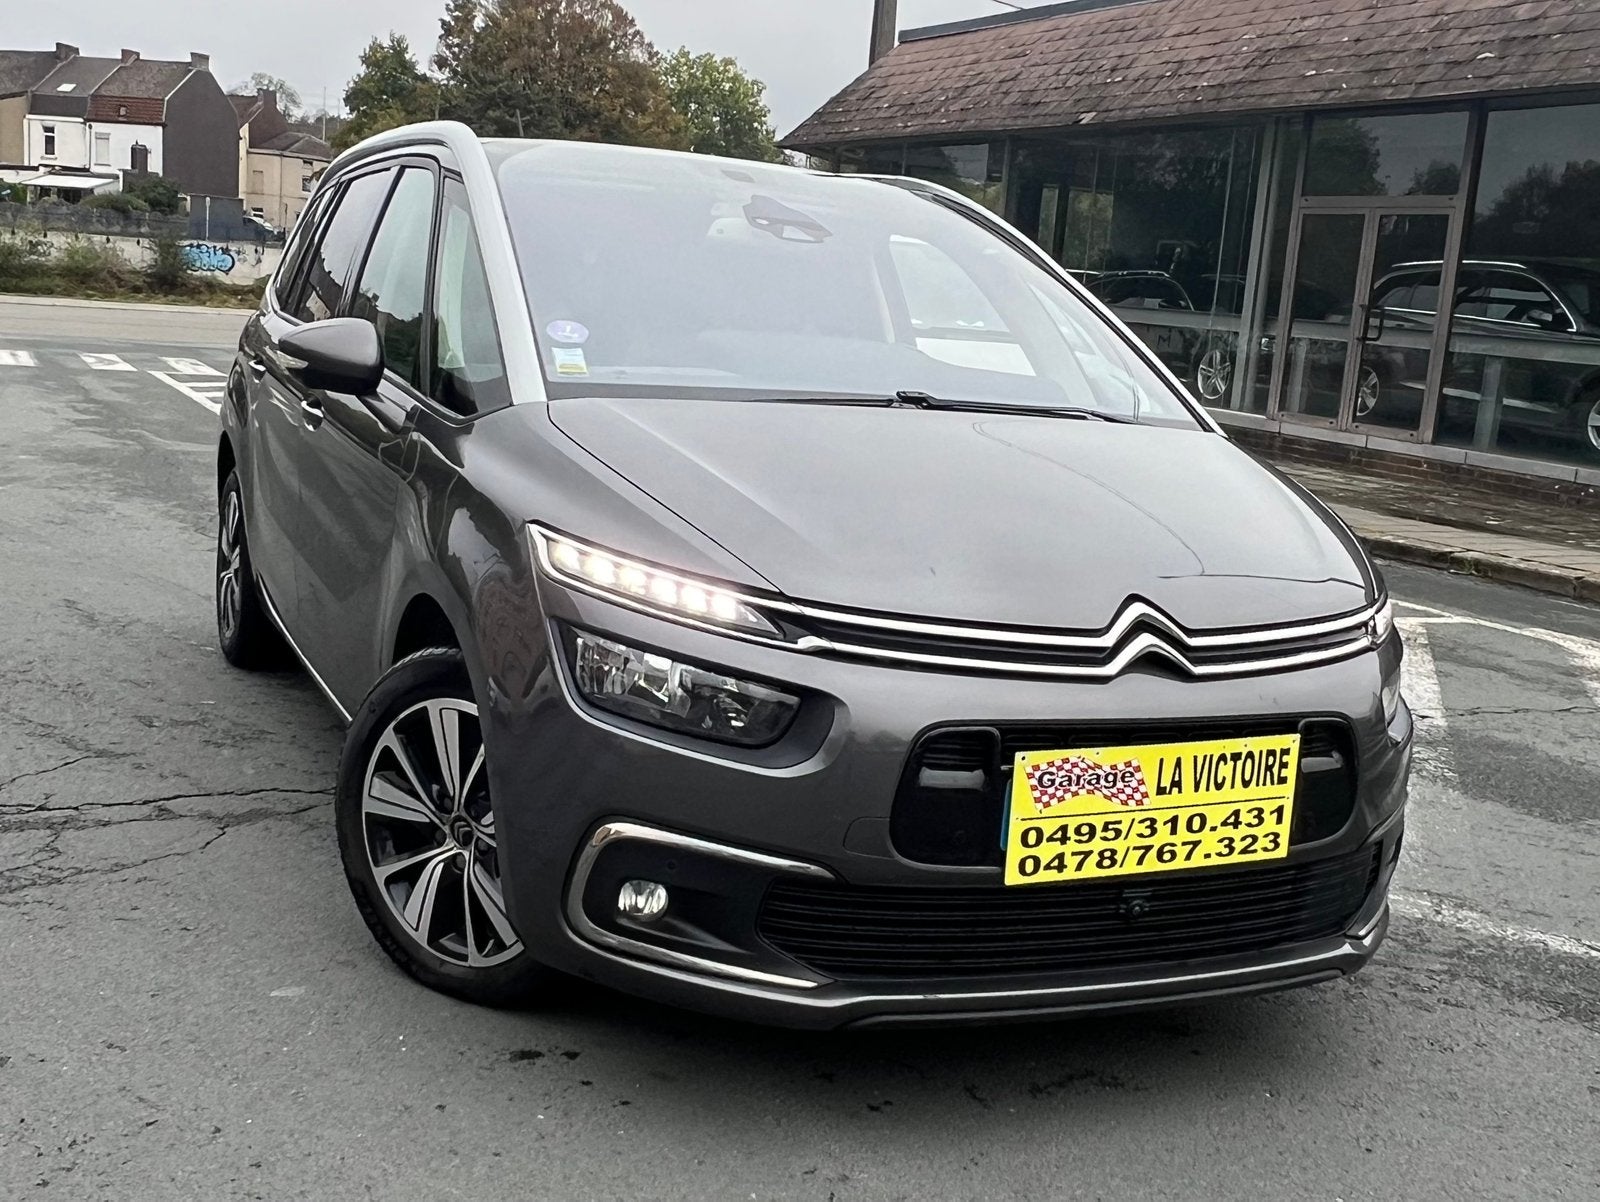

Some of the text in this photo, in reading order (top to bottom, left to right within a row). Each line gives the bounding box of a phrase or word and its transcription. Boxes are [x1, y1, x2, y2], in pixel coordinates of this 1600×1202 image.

[1037, 748, 1291, 796] Garage LA VICTOIRE
[1020, 805, 1285, 849] 0495/310.431
[1017, 832, 1282, 877] 0478/767.323
